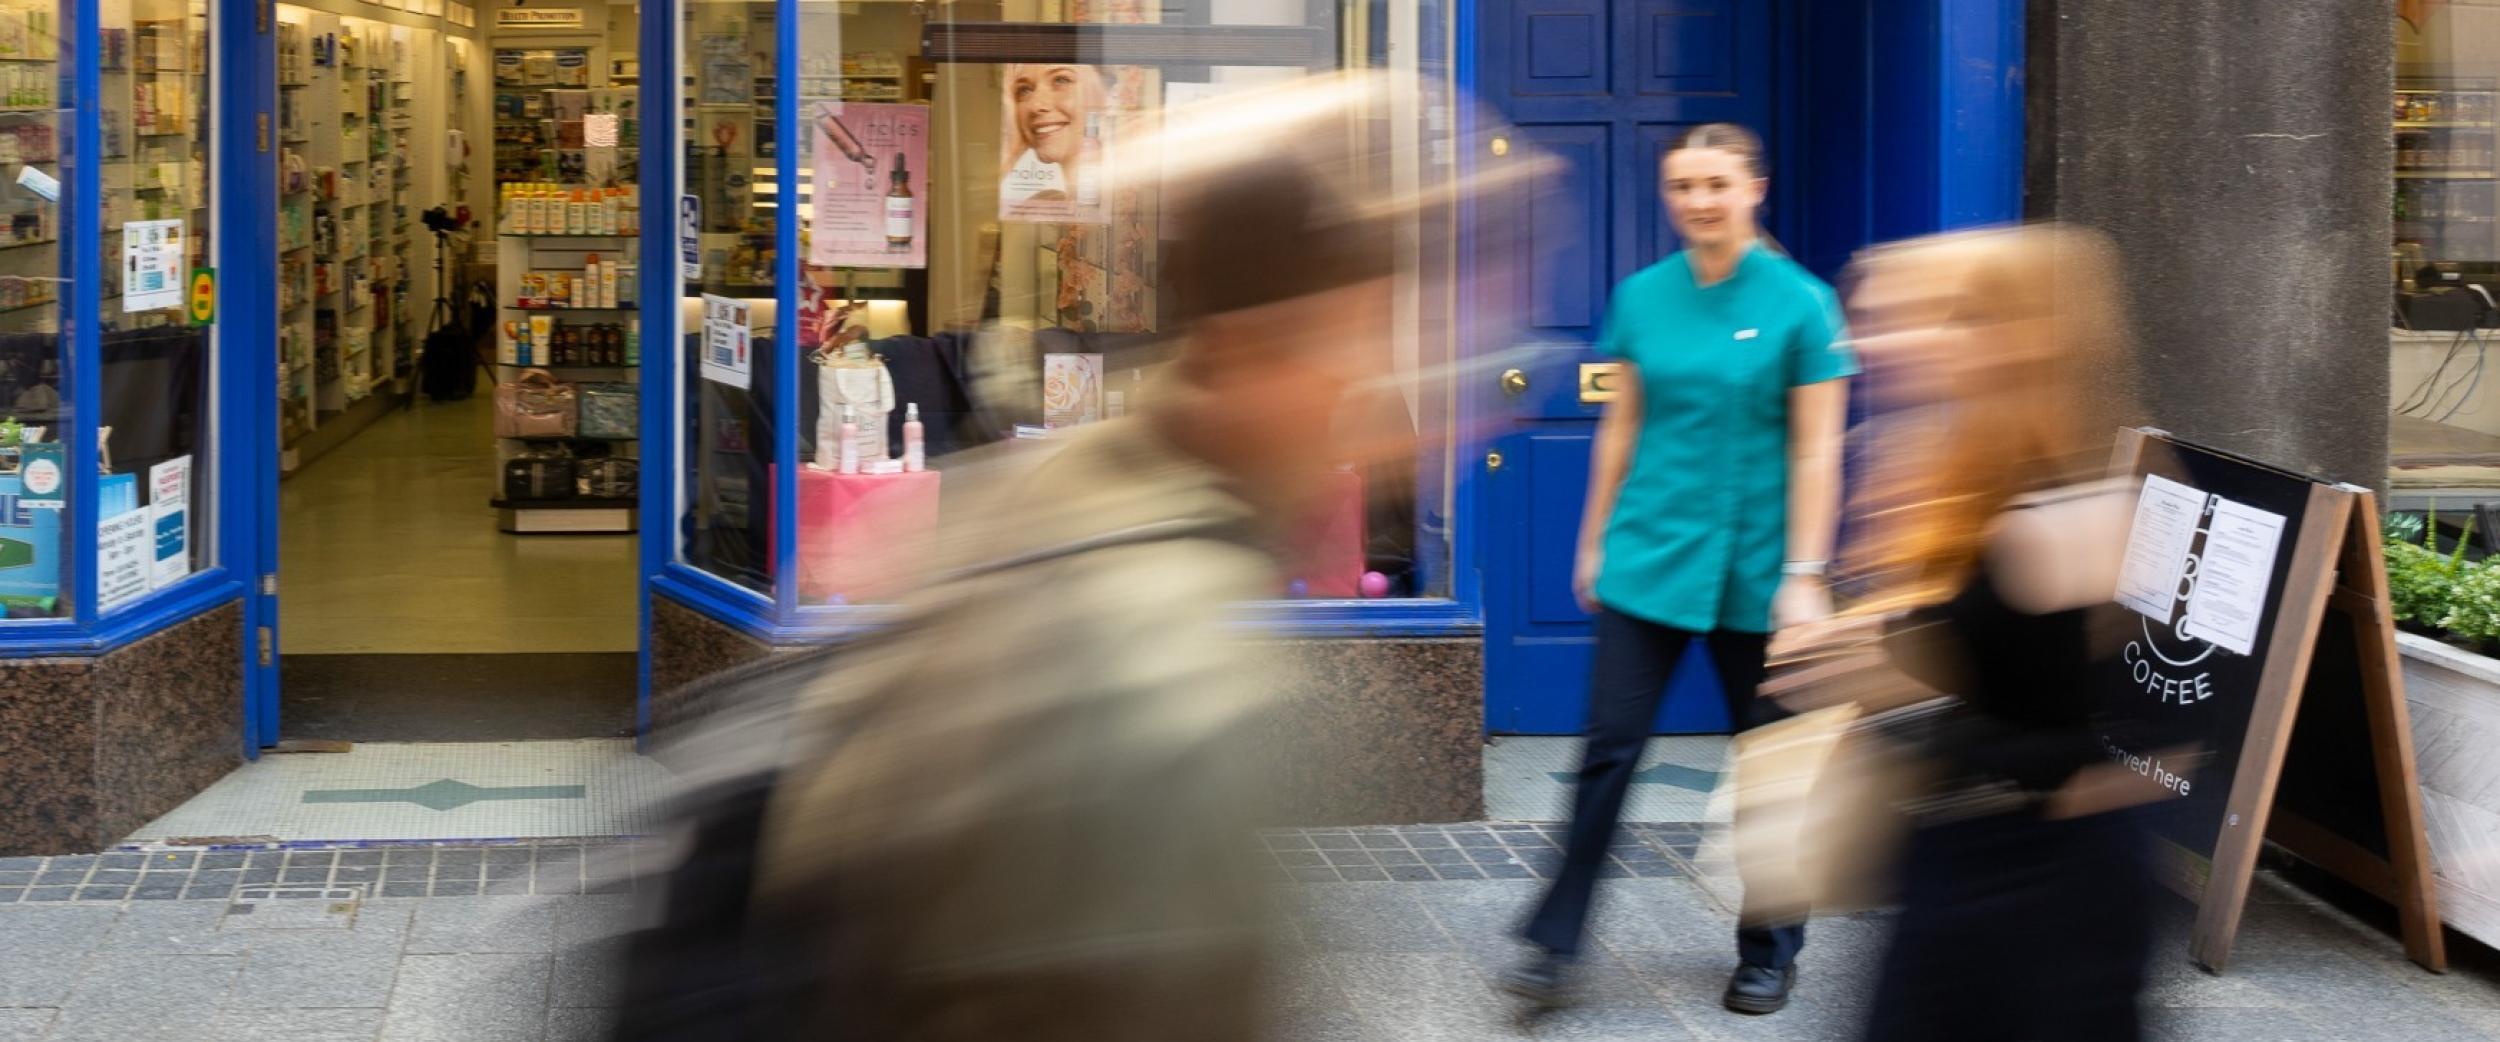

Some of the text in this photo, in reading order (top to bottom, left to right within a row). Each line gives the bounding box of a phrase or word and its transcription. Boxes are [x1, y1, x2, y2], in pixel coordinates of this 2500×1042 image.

[2124, 641, 2214, 705] COFFEE
[2101, 735, 2191, 796] Served here
